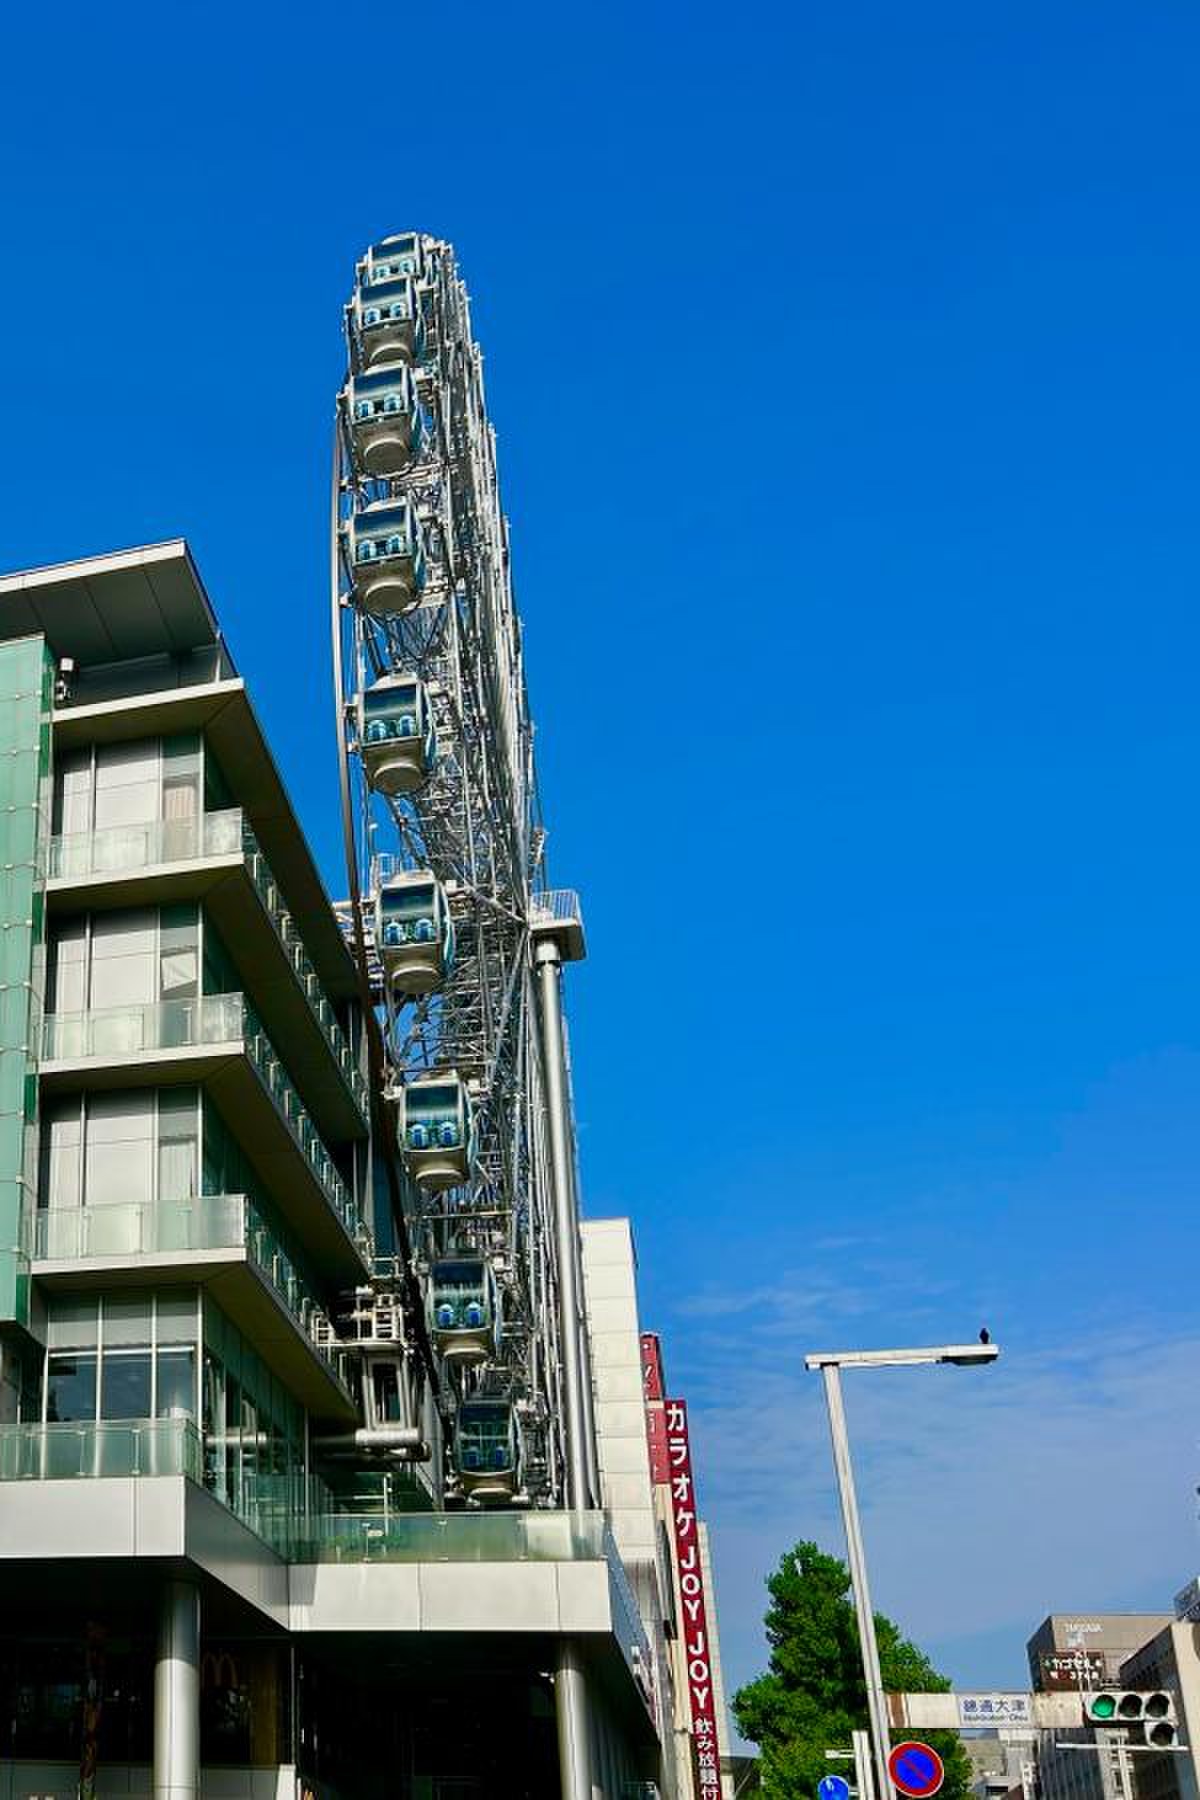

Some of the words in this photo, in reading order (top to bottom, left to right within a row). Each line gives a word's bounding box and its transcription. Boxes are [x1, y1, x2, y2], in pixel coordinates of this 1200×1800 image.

[666, 1403, 696, 1538] カラオケ
[680, 1545, 702, 1622] JOY
[688, 1631, 710, 1710] JOY
